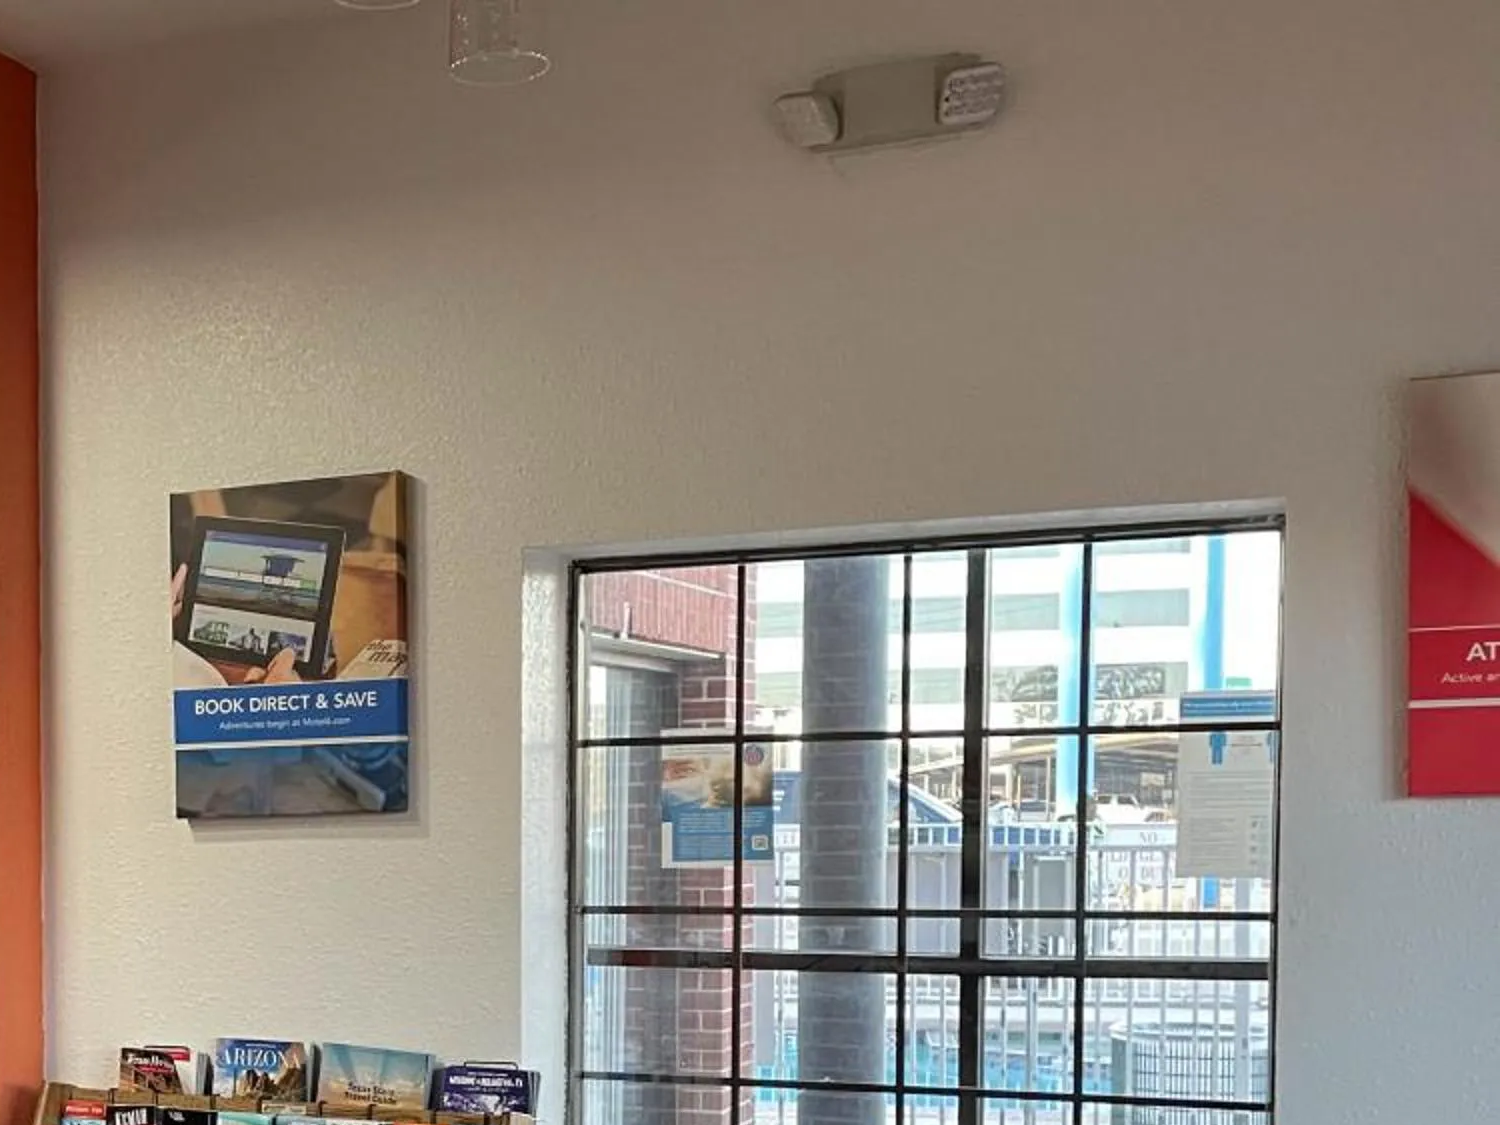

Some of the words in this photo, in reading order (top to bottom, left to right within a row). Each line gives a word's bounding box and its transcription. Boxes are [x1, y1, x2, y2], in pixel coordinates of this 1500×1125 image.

[1441, 672, 1483, 684] Active
[195, 697, 244, 715] BOOK
[250, 695, 311, 713] DIRECT
[315, 693, 329, 709] &
[333, 691, 377, 709] SAVE
[219, 720, 265, 731] Adventures
[266, 719, 290, 731] begin
[218, 1047, 301, 1069] ARIZONA
